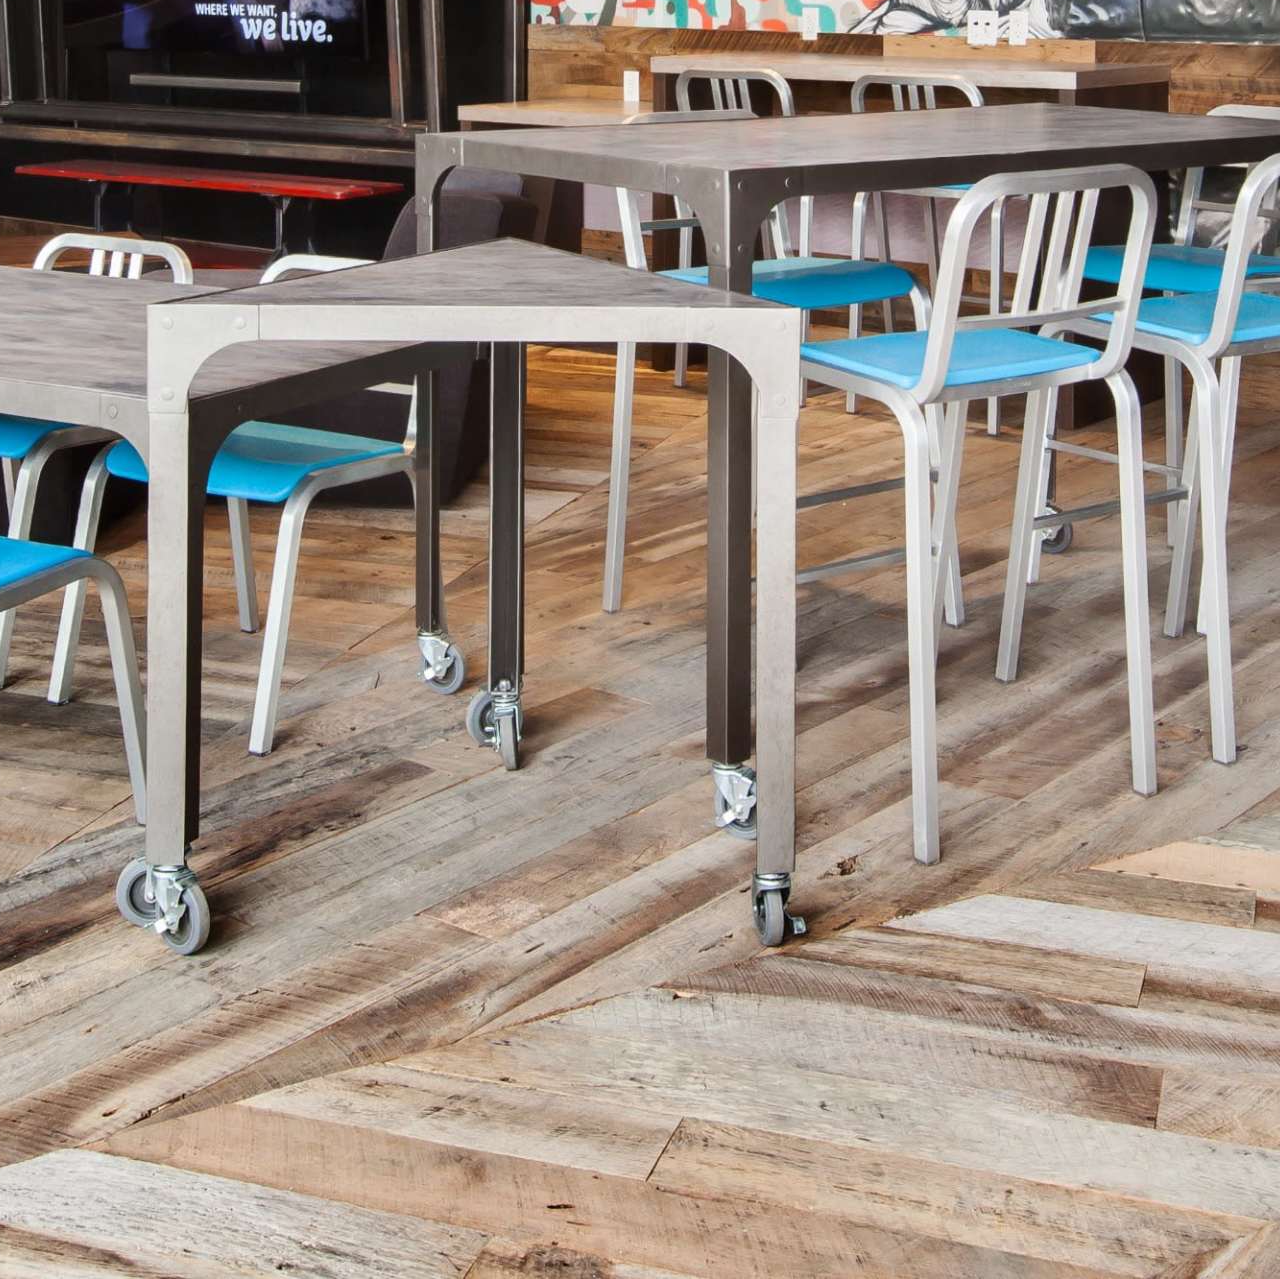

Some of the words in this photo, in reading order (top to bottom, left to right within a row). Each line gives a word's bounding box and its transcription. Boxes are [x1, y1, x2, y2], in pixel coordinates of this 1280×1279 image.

[195, 3, 228, 17] WHERE
[229, 4, 246, 17] WE
[247, 5, 278, 19] WANT,
[239, 17, 277, 41] we
[281, 11, 333, 43] live.
